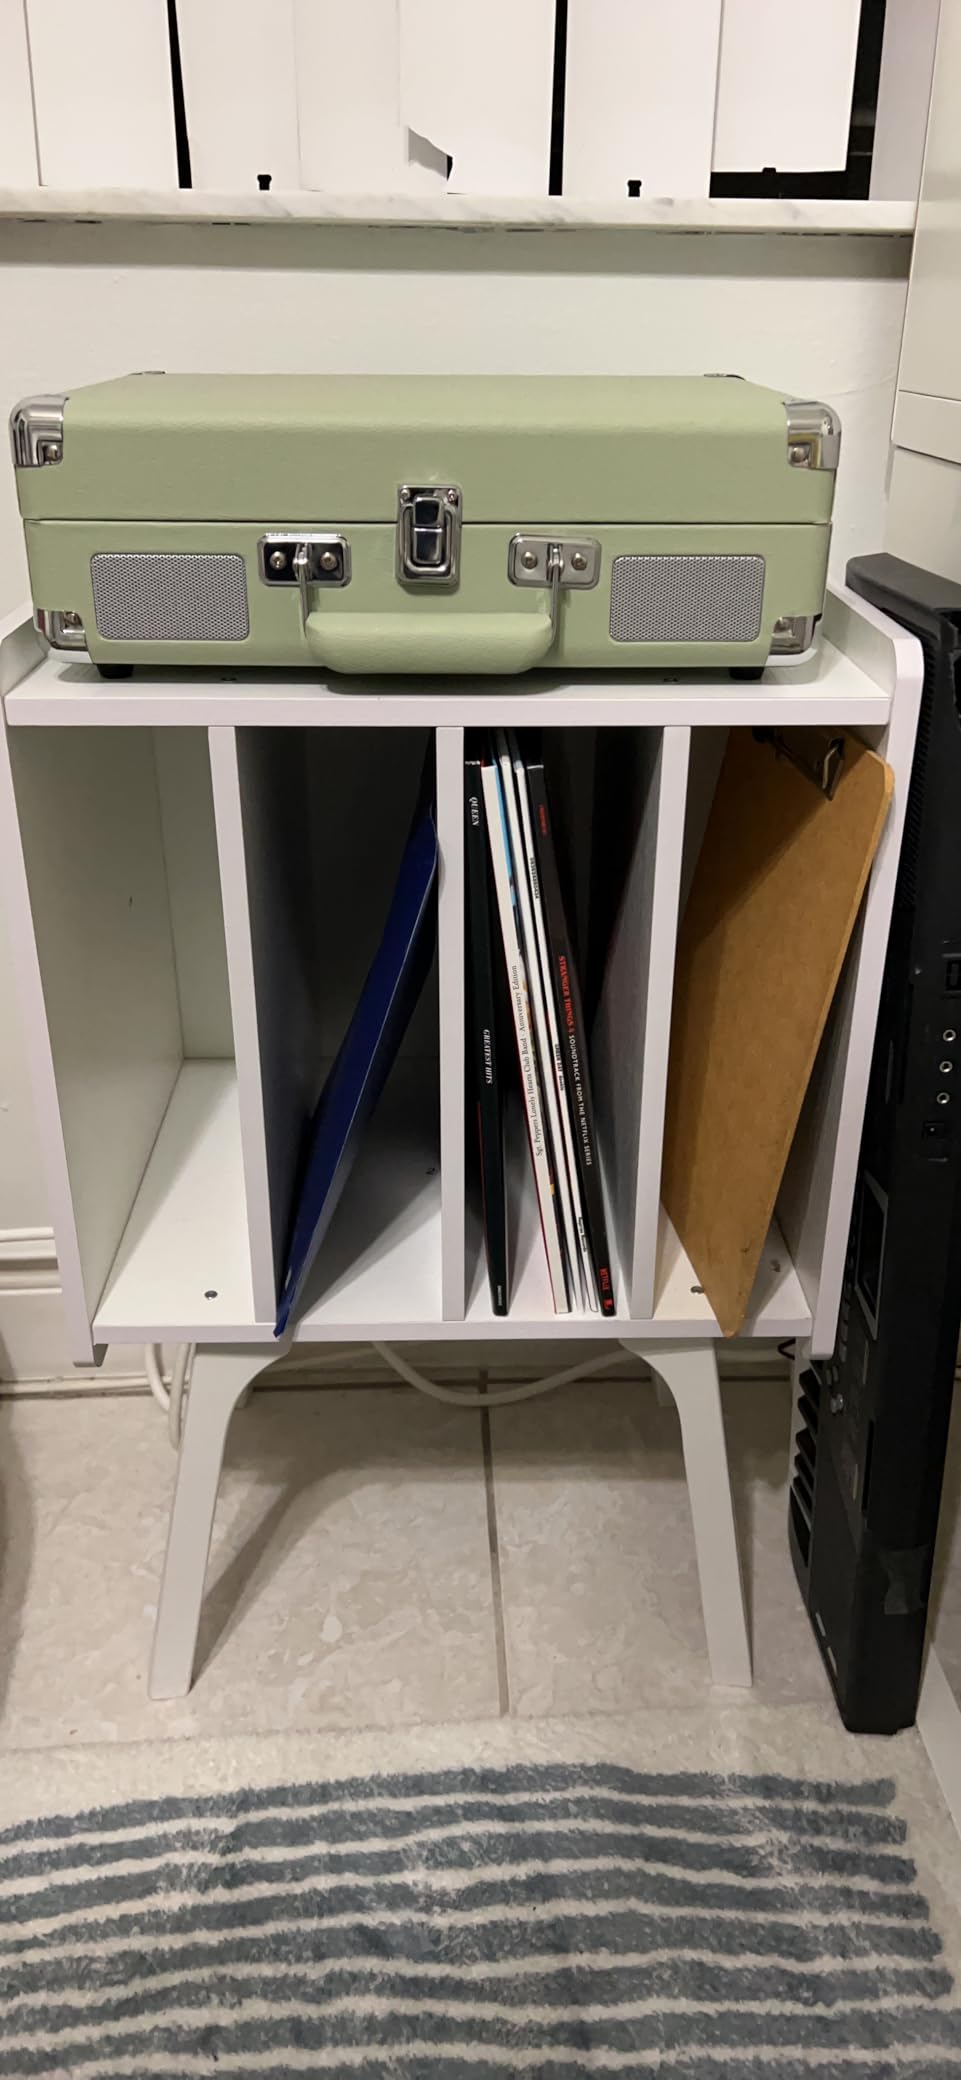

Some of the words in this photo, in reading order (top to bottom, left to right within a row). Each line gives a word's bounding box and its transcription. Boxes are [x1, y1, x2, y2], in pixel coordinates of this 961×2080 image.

[469, 796, 479, 826] QUEEN
[512, 965, 520, 990] Edition
[560, 955, 570, 997] STRANGER
[515, 992, 525, 1032] Anniversary
[565, 998, 574, 1026] THINGS
[483, 1029, 493, 1066] GREATEST
[520, 1037, 529, 1055] Band
[568, 1034, 580, 1081] SOUNDTRACK
[484, 1066, 493, 1084] HITS
[522, 1056, 530, 1073] Club
[526, 1073, 535, 1094] Hearts
[575, 1083, 584, 1101] FROM
[528, 1099, 537, 1118] Lonely
[578, 1102, 586, 1116] THE
[580, 1117, 589, 1143] NETFLIX
[584, 1145, 592, 1166] SERIES
